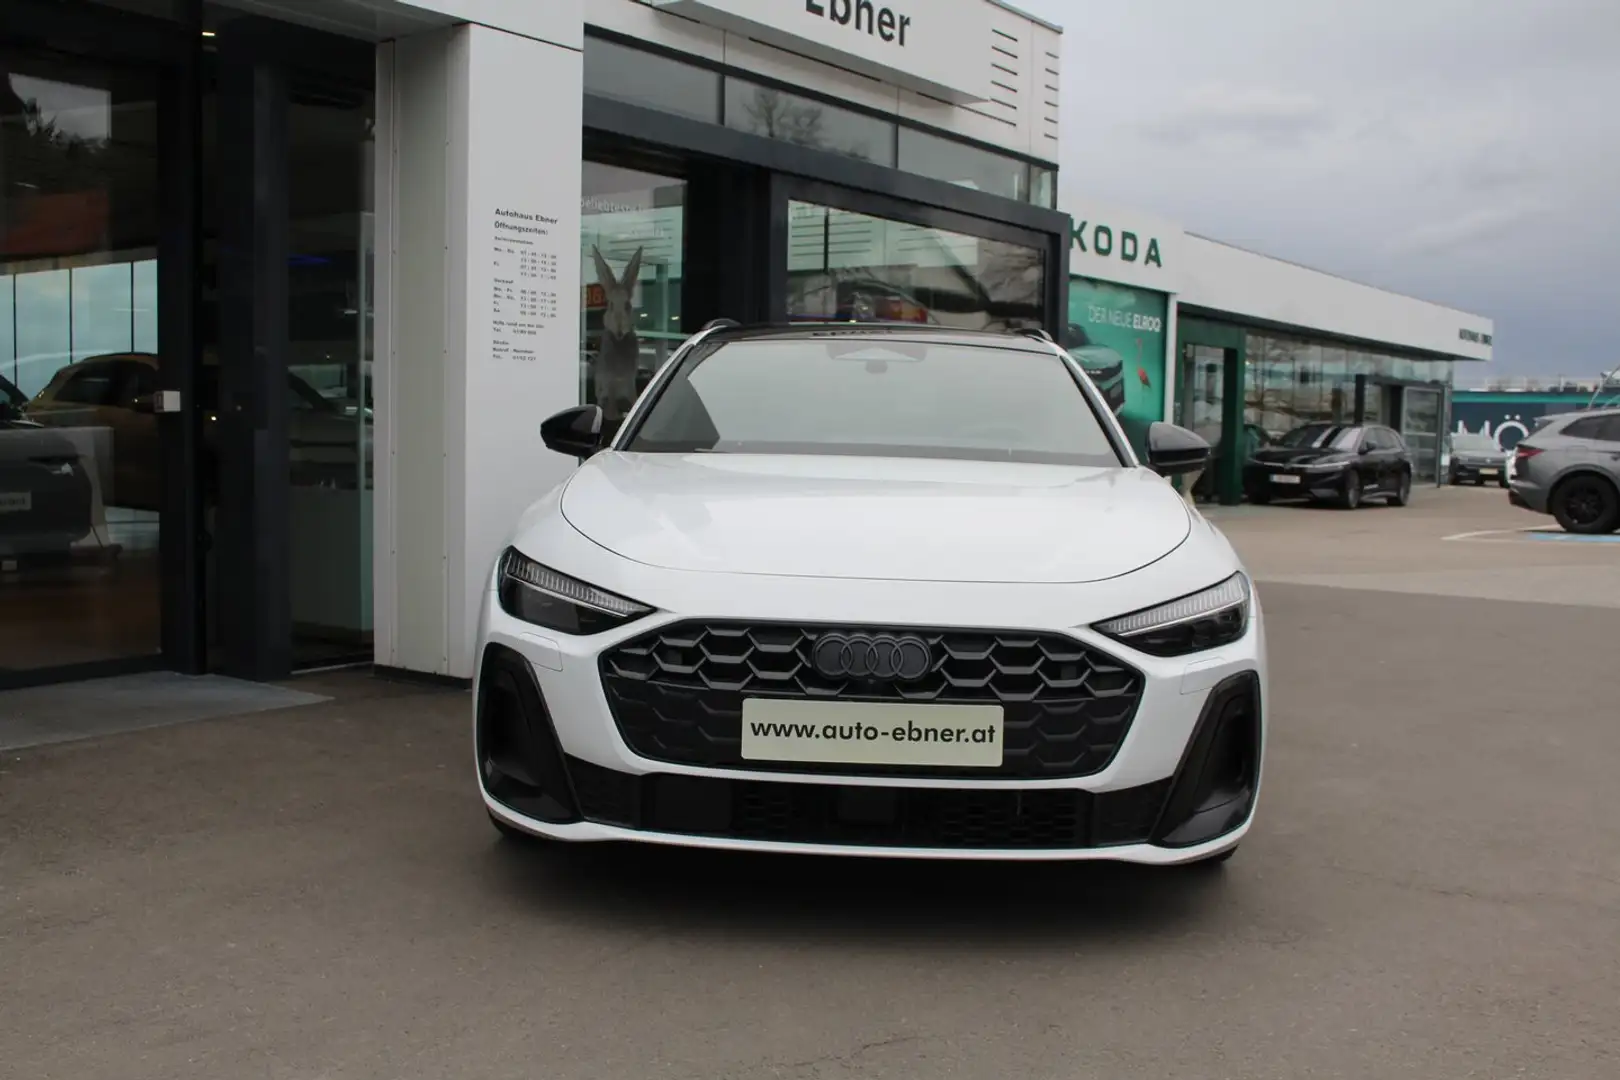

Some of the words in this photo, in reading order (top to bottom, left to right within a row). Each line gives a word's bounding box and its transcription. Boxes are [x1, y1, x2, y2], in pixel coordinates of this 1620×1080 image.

[495, 208, 533, 221] Autohaus
[535, 214, 558, 225] Ebner
[750, 720, 996, 743] www.auto-ebner.at
